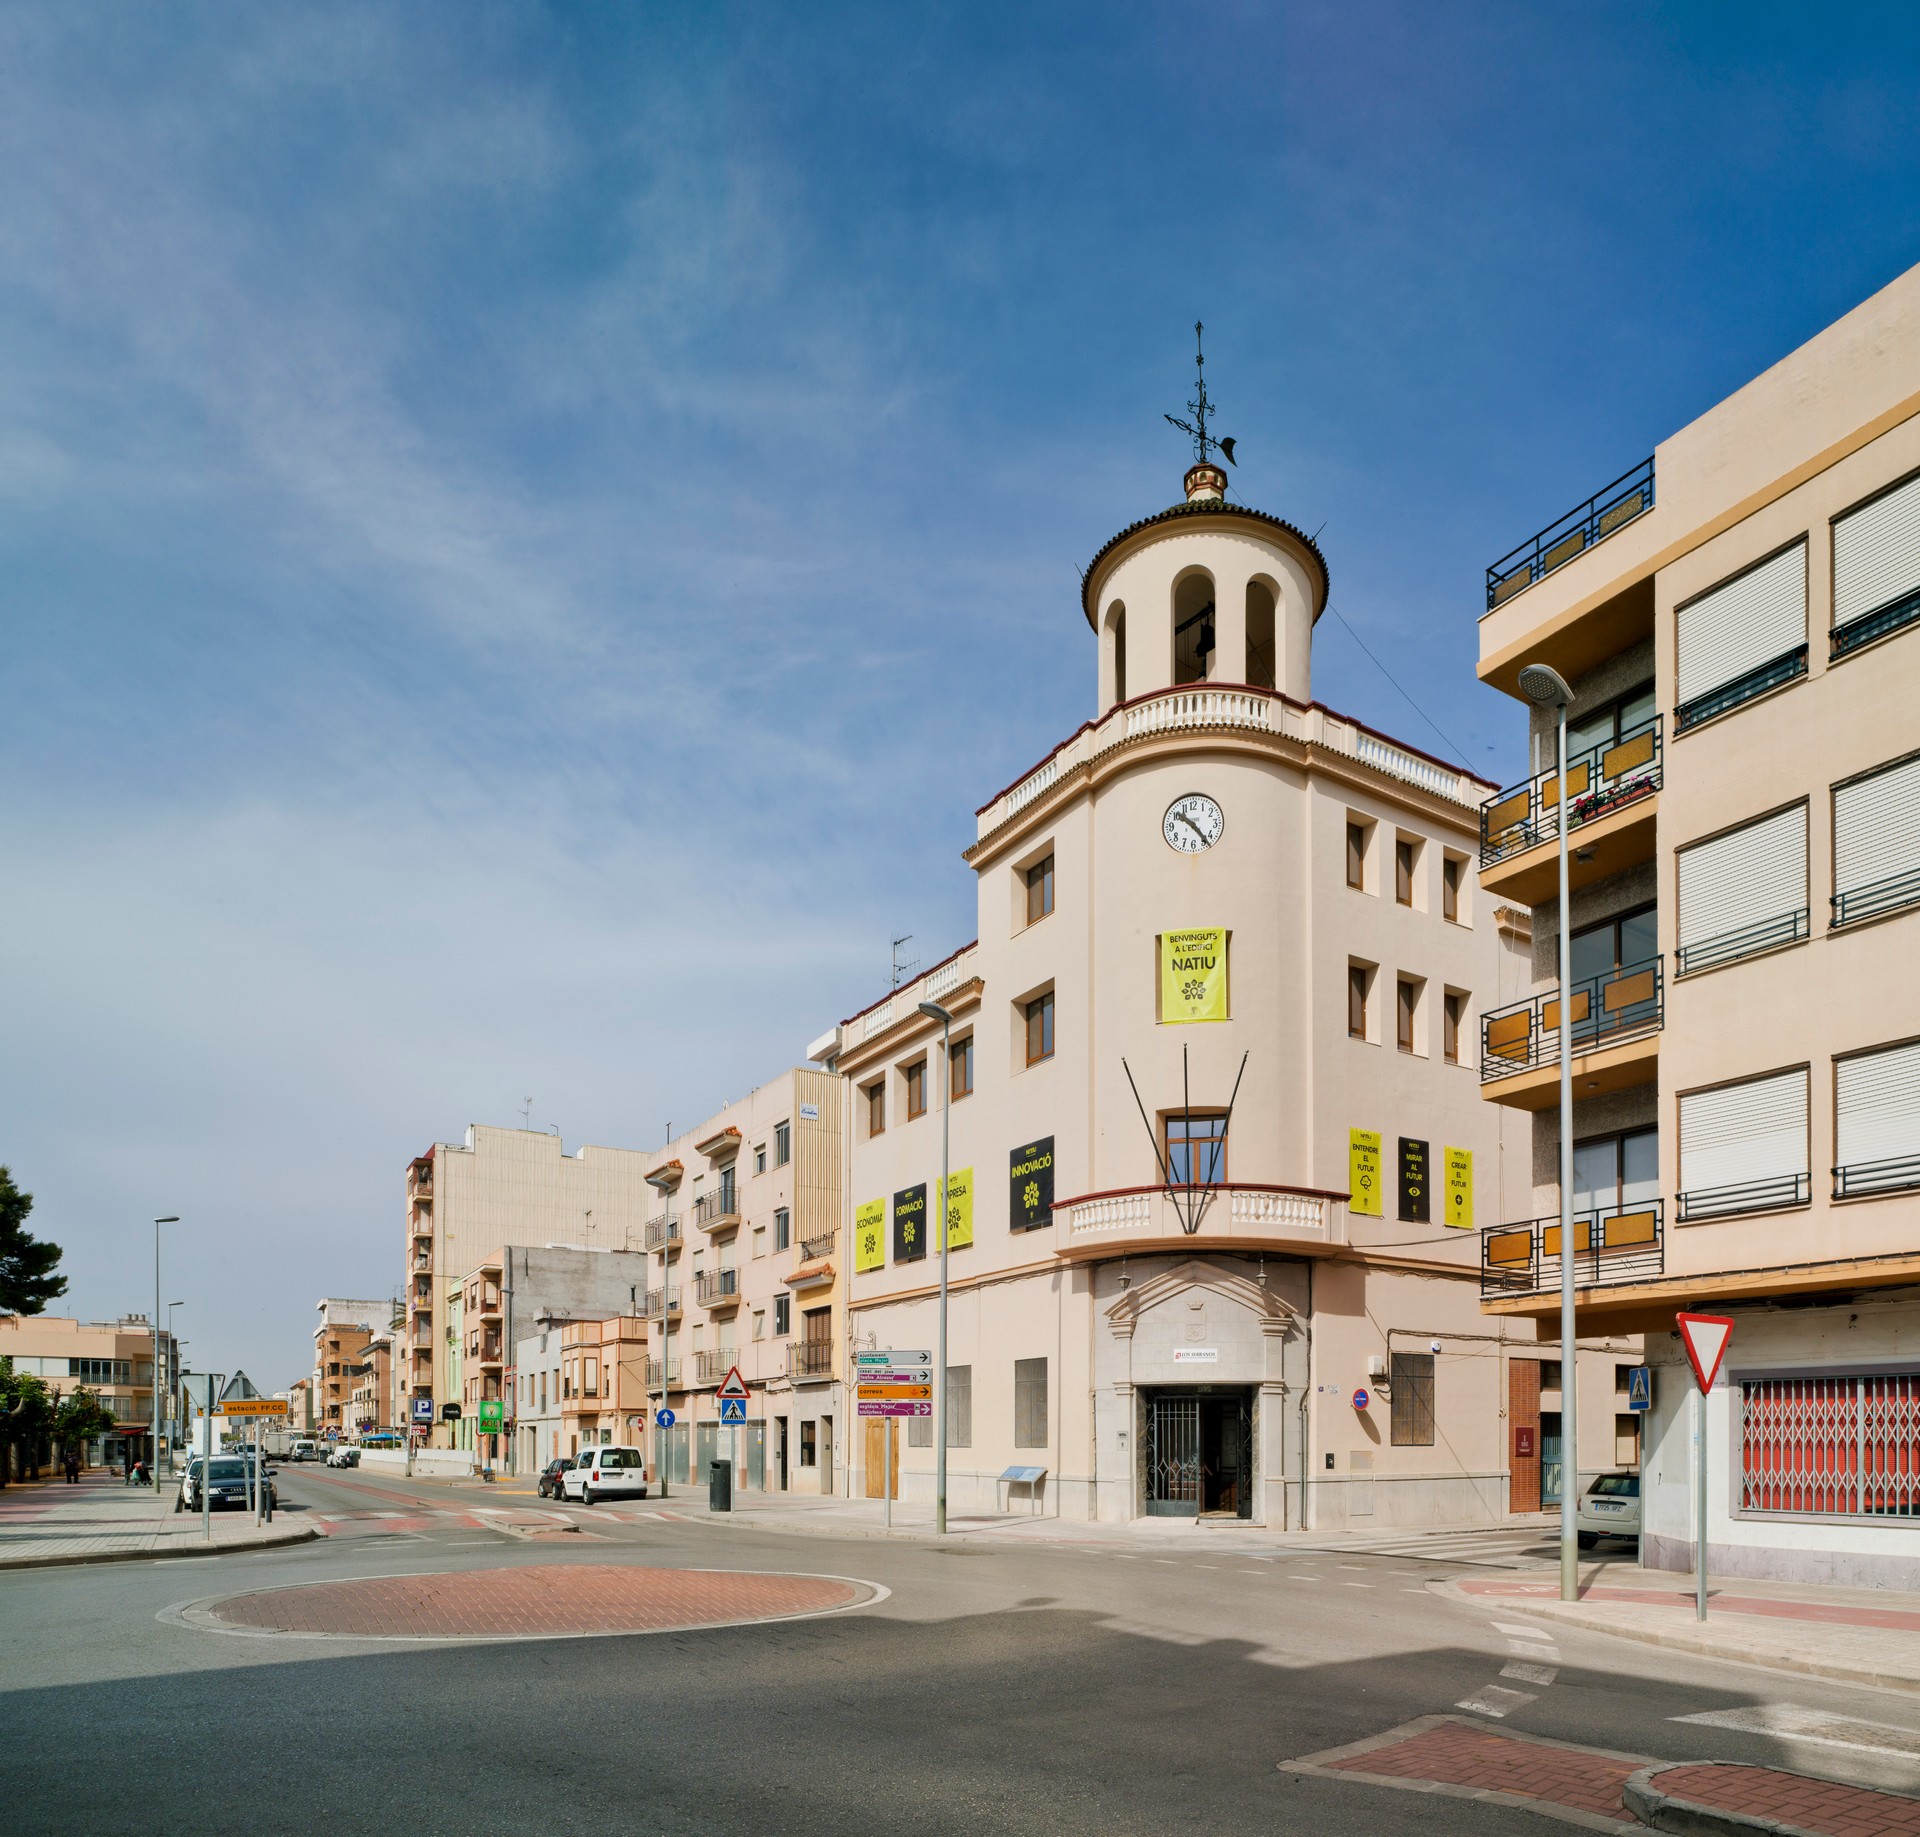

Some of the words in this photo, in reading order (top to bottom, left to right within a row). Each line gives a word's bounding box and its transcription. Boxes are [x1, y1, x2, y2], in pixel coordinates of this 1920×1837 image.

[1182, 804, 1187, 813] 11
[1190, 800, 1197, 810] 12
[1173, 811, 1180, 820] 10
[1208, 808, 1214, 817] 2
[1169, 822, 1174, 832] 9
[1212, 818, 1218, 828] 3
[1173, 832, 1178, 842] 8
[1208, 830, 1213, 839] 4
[1182, 838, 1187, 847] 7
[1191, 840, 1196, 849] 6
[1170, 932, 1217, 943] BENVINGUTS
[1172, 956, 1216, 971] NATIU
[1352, 1144, 1378, 1154] ENTENDRE
[1406, 1154, 1422, 1162] MIRAR
[1012, 1152, 1051, 1178] INNOVACIÓ
[1357, 1164, 1374, 1172] FUTUR
[1451, 1162, 1466, 1170] CREAR
[1406, 1172, 1422, 1180] FUTUR
[1451, 1180, 1466, 1188] FUTUR
[941, 1185, 966, 1200] PRESA
[896, 1197, 923, 1217] FORMACIÓ
[857, 1213, 882, 1229] ECONOMIA
[418, 1401, 429, 1412] P
